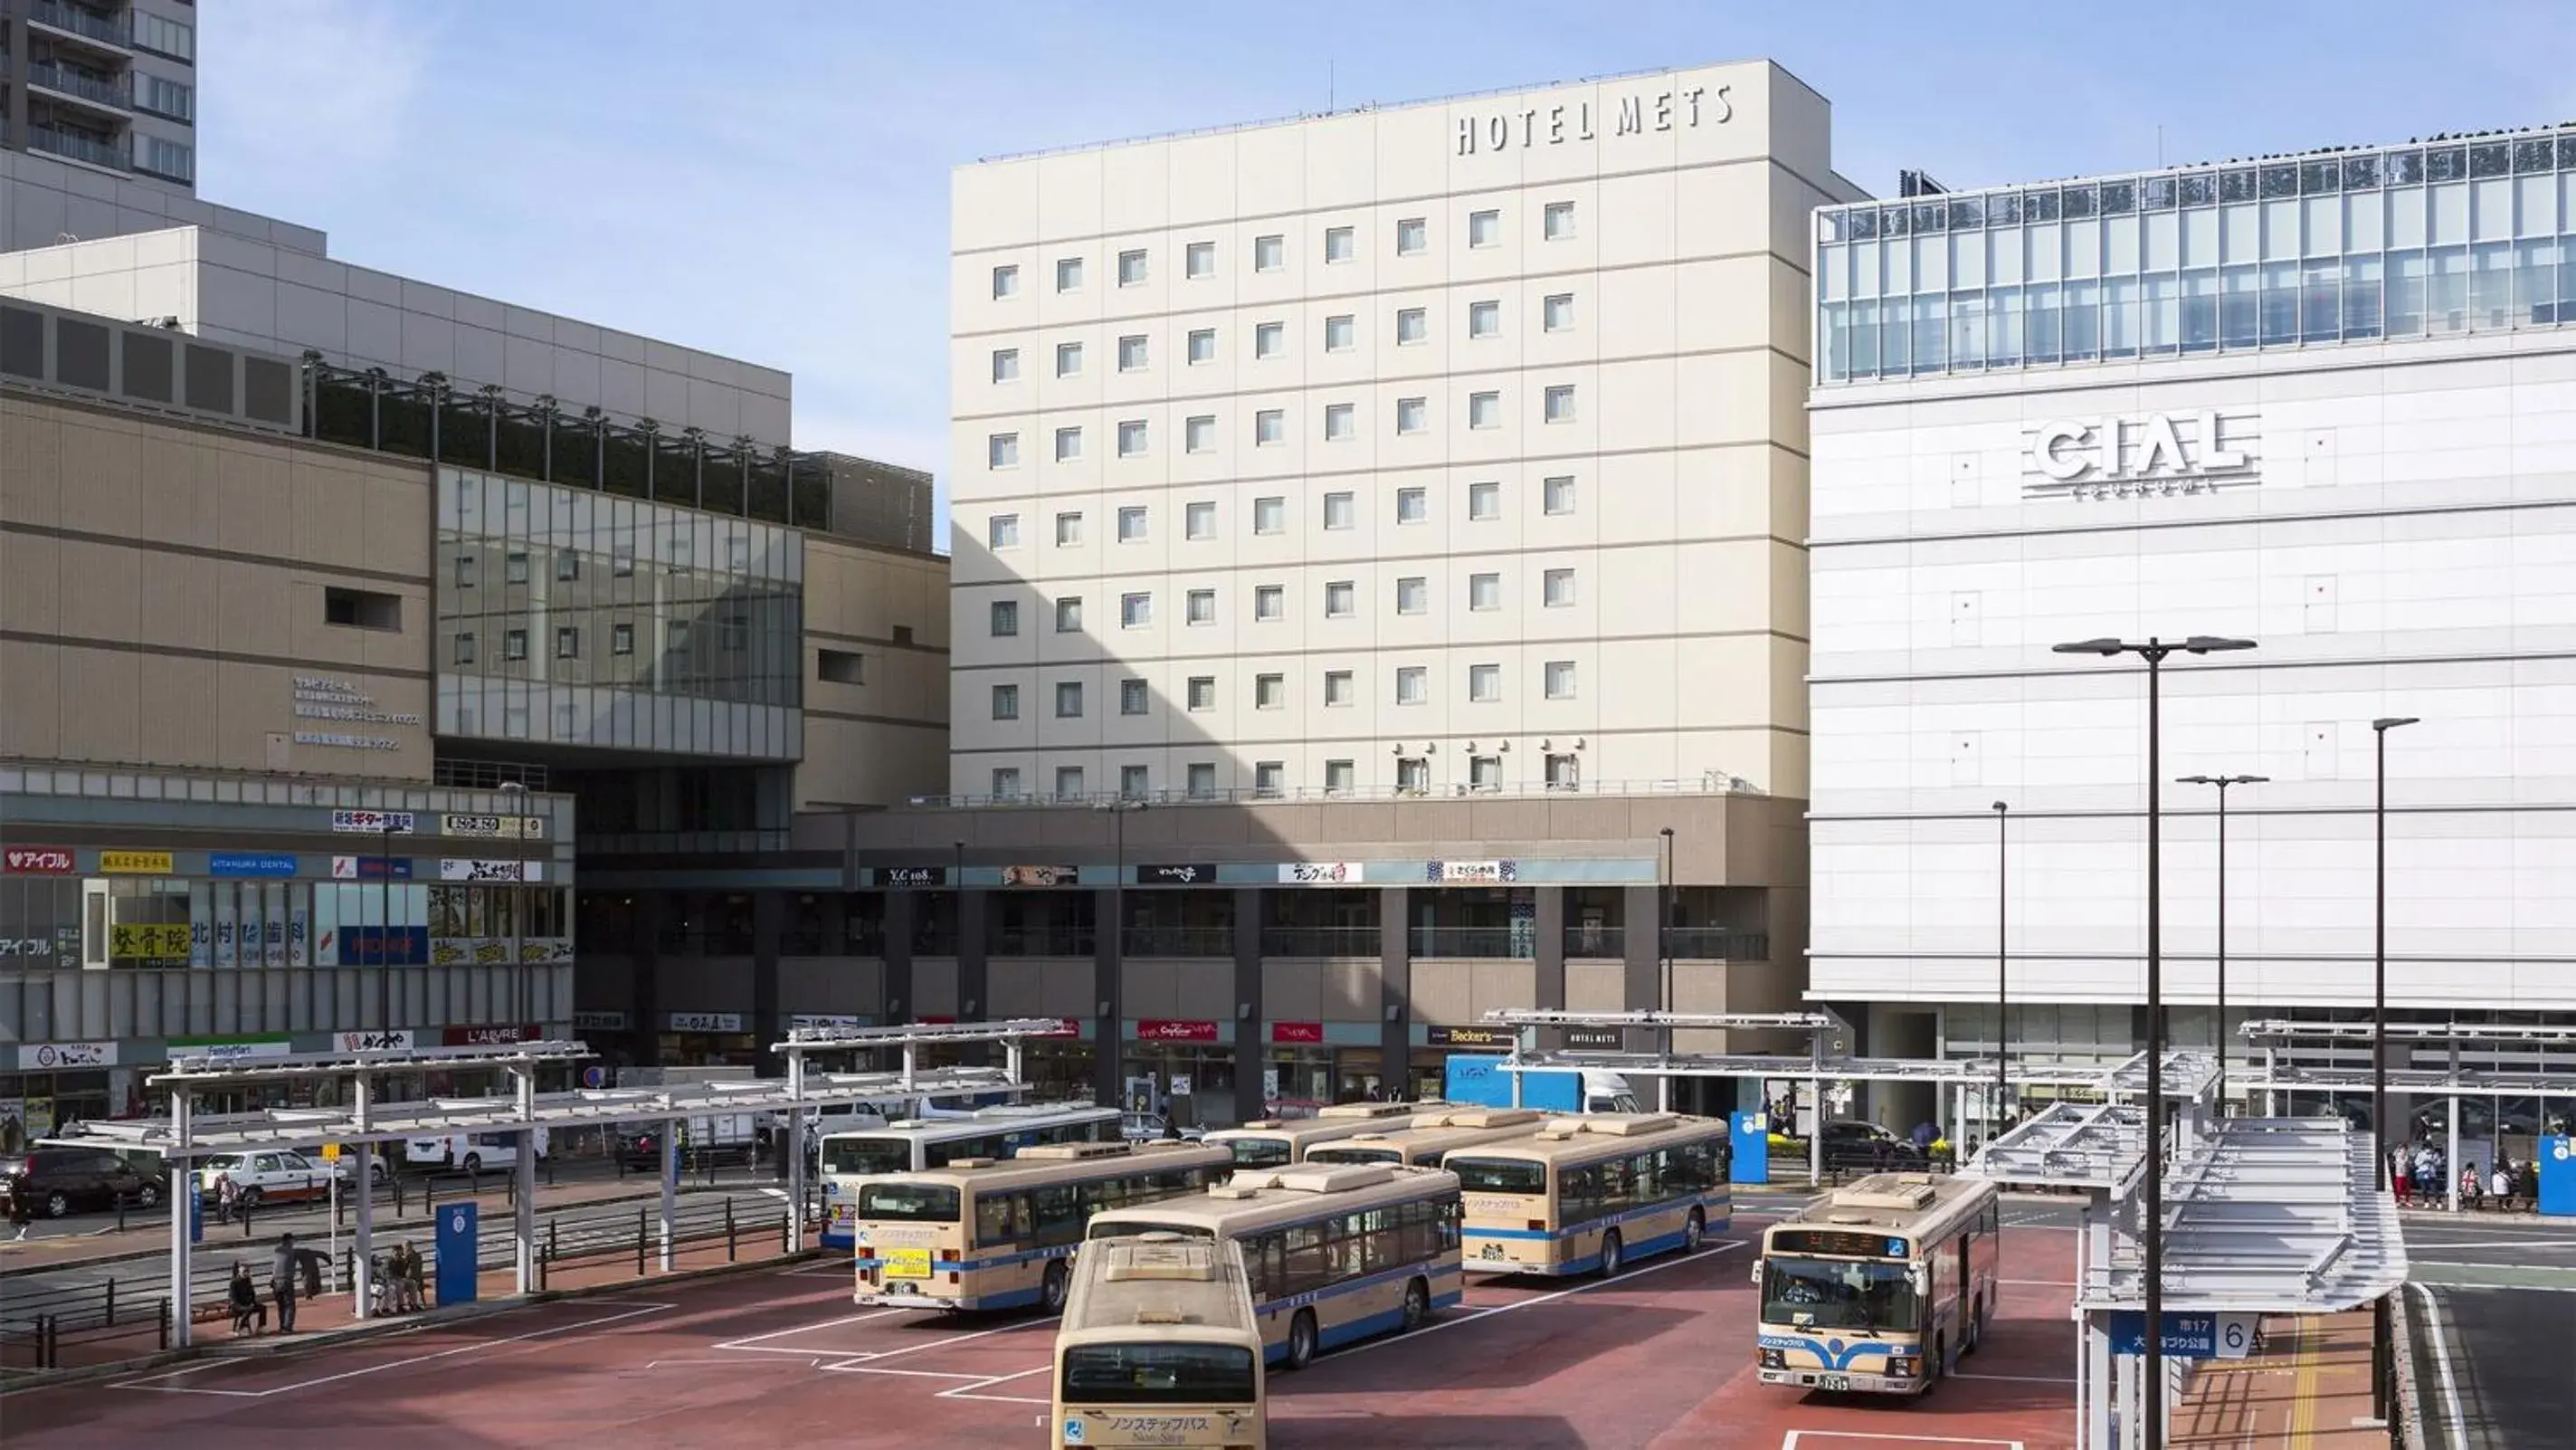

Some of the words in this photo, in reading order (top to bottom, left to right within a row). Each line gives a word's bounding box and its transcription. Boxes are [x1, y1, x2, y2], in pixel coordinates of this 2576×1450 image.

[1458, 101, 1594, 156] HOTEL
[1614, 85, 1733, 137] METS
[2034, 409, 2251, 481] CIAL
[24, 851, 70, 868] アイフル
[1450, 1028, 1492, 1043] Becker's
[2225, 1322, 2244, 1348] 6
[1110, 1417, 1210, 1431] ノンステップバス
